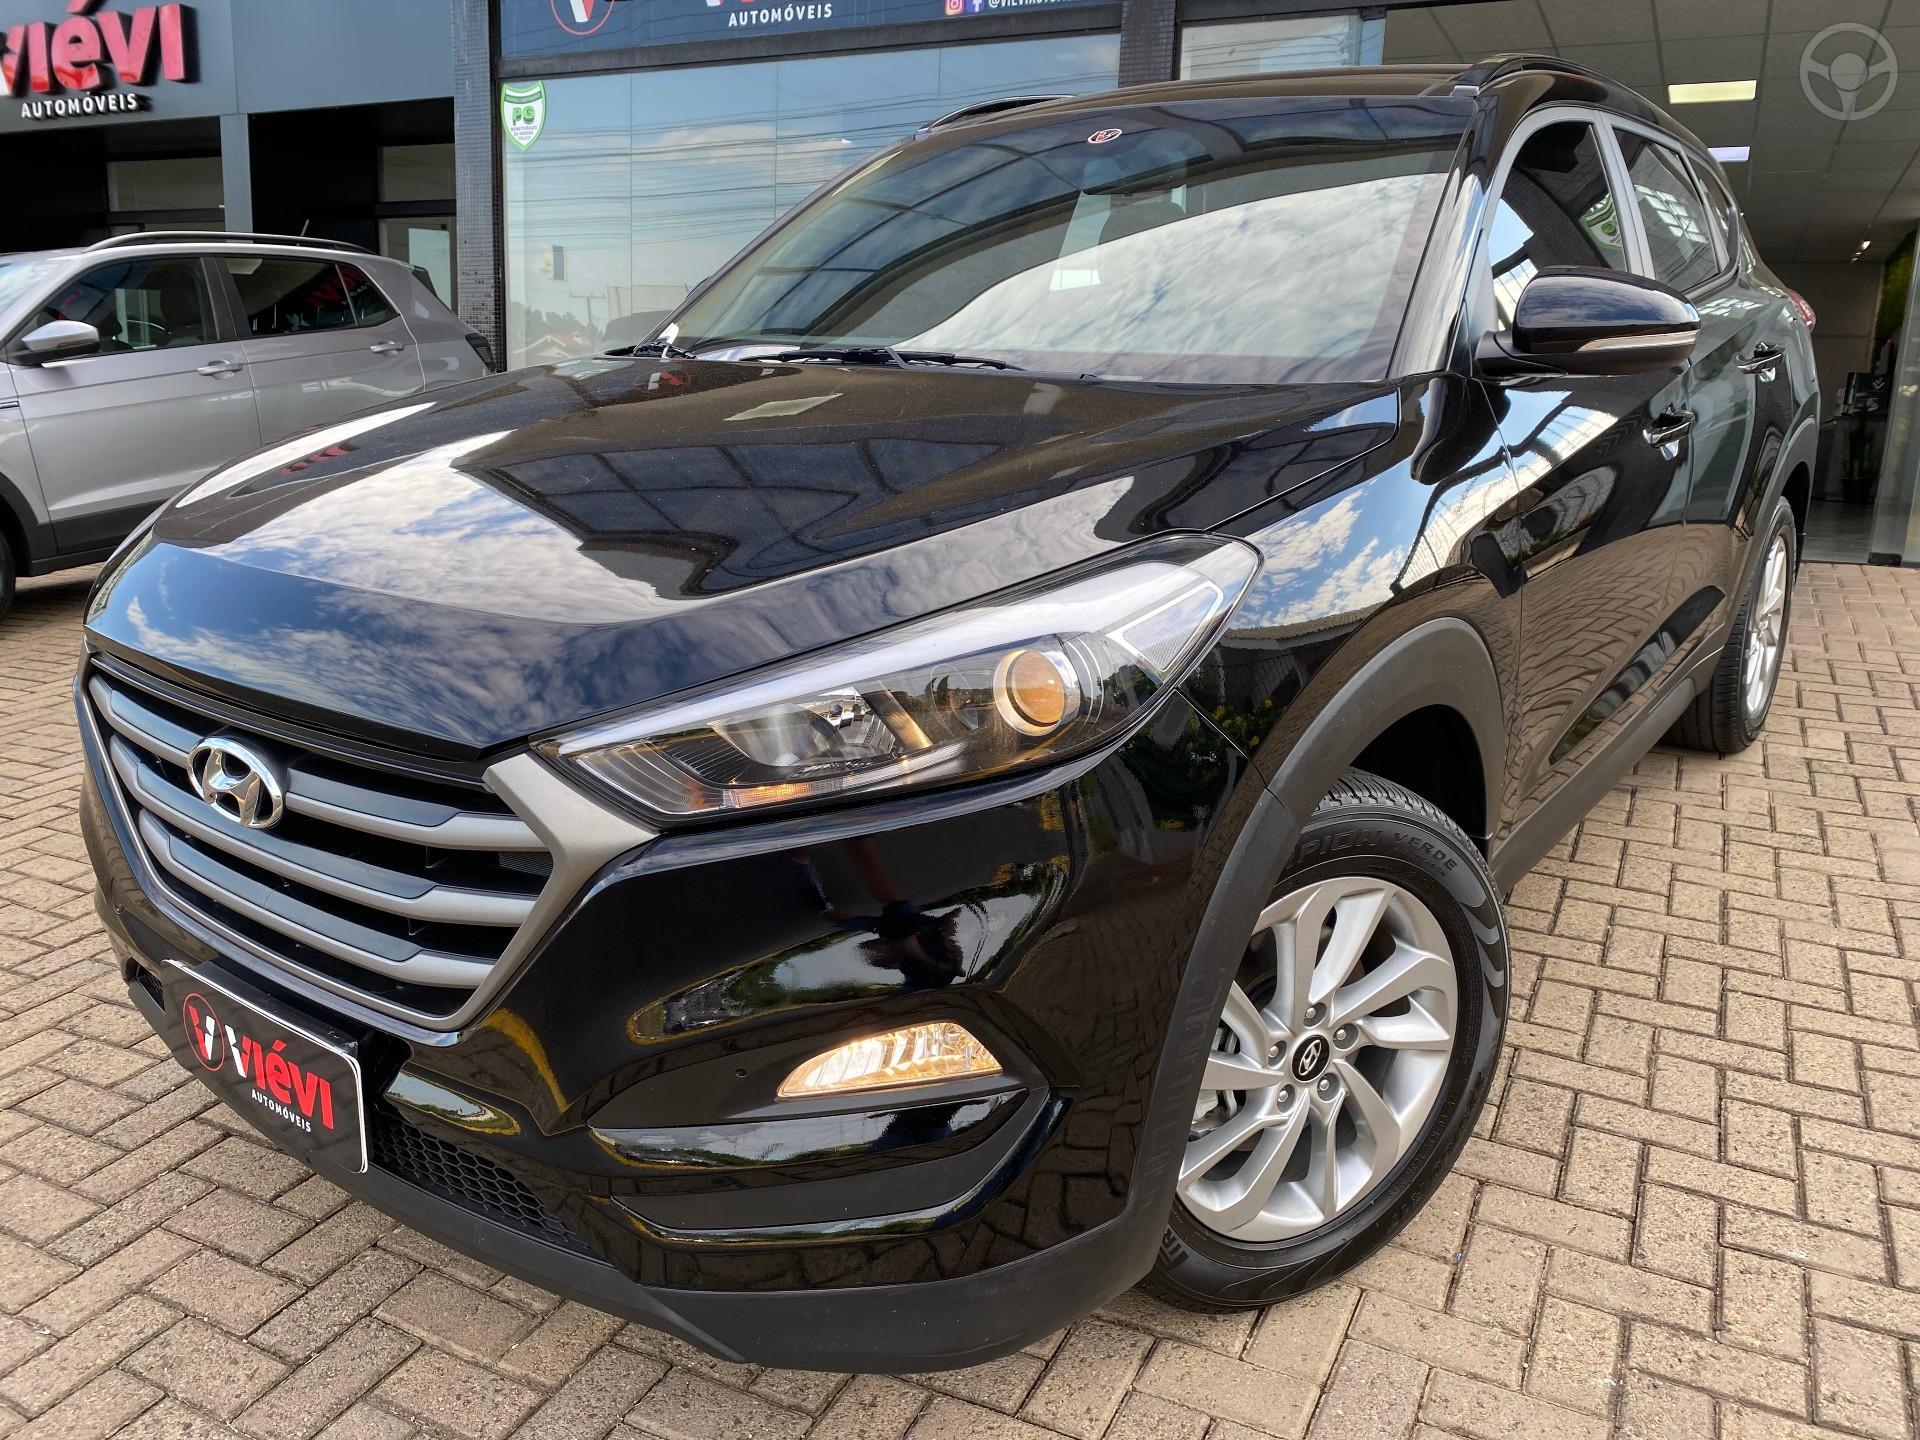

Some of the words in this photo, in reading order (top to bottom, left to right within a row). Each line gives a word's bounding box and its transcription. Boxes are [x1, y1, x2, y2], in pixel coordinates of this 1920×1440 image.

[728, 4, 833, 27] AUTOMÓVEIS
[21, 91, 138, 119] AUTOMÓVEIS
[1394, 832, 1458, 871] VERDE
[251, 1088, 312, 1133] AUTOMÓVEIS
